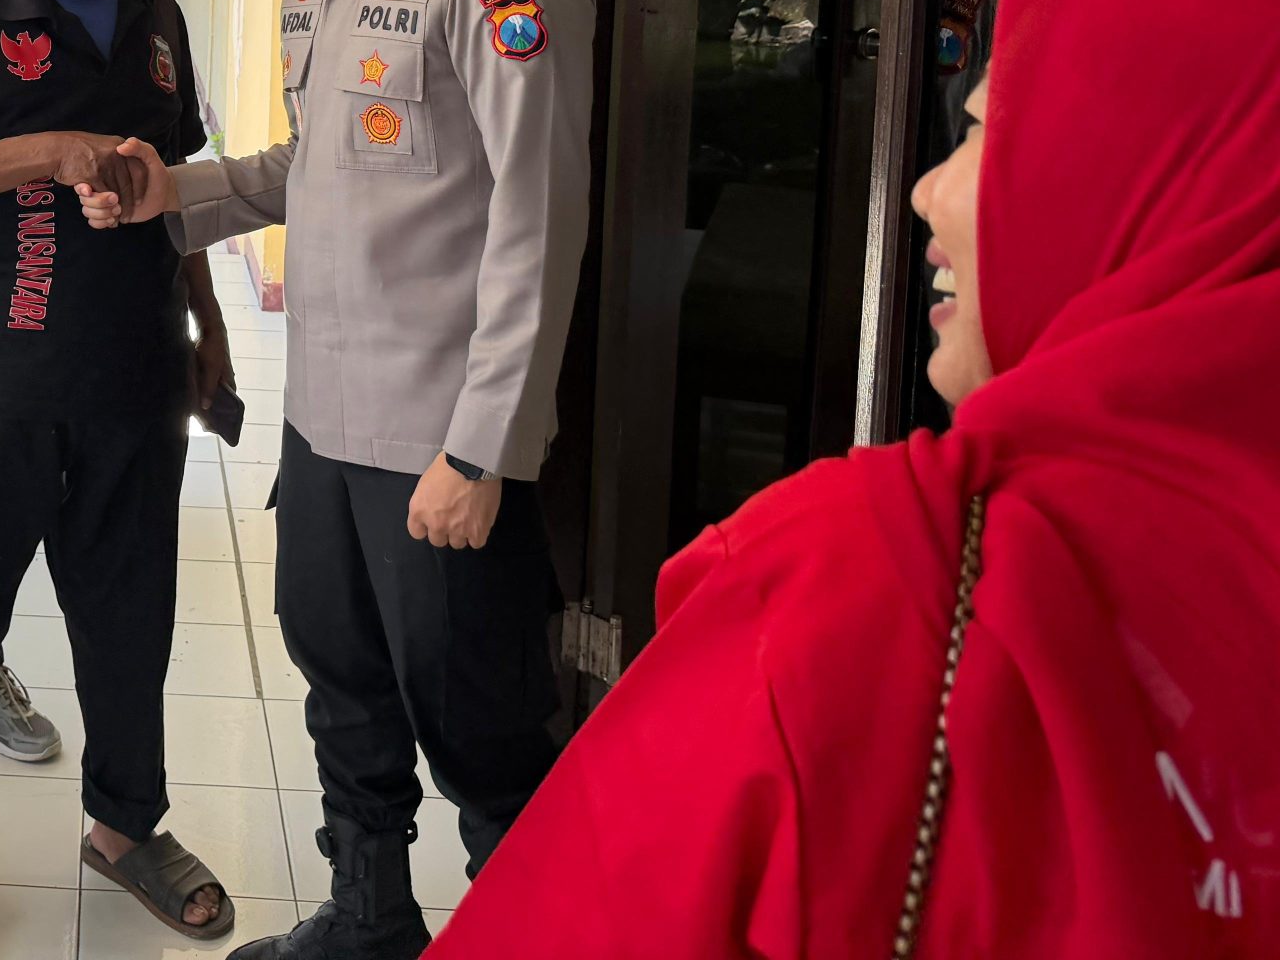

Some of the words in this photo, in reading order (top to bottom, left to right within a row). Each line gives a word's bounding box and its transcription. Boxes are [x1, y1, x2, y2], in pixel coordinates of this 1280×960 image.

[281, 11, 313, 35] AFDAL
[357, 5, 419, 35] POLRI
[7, 211, 56, 331] NUSANTARA
